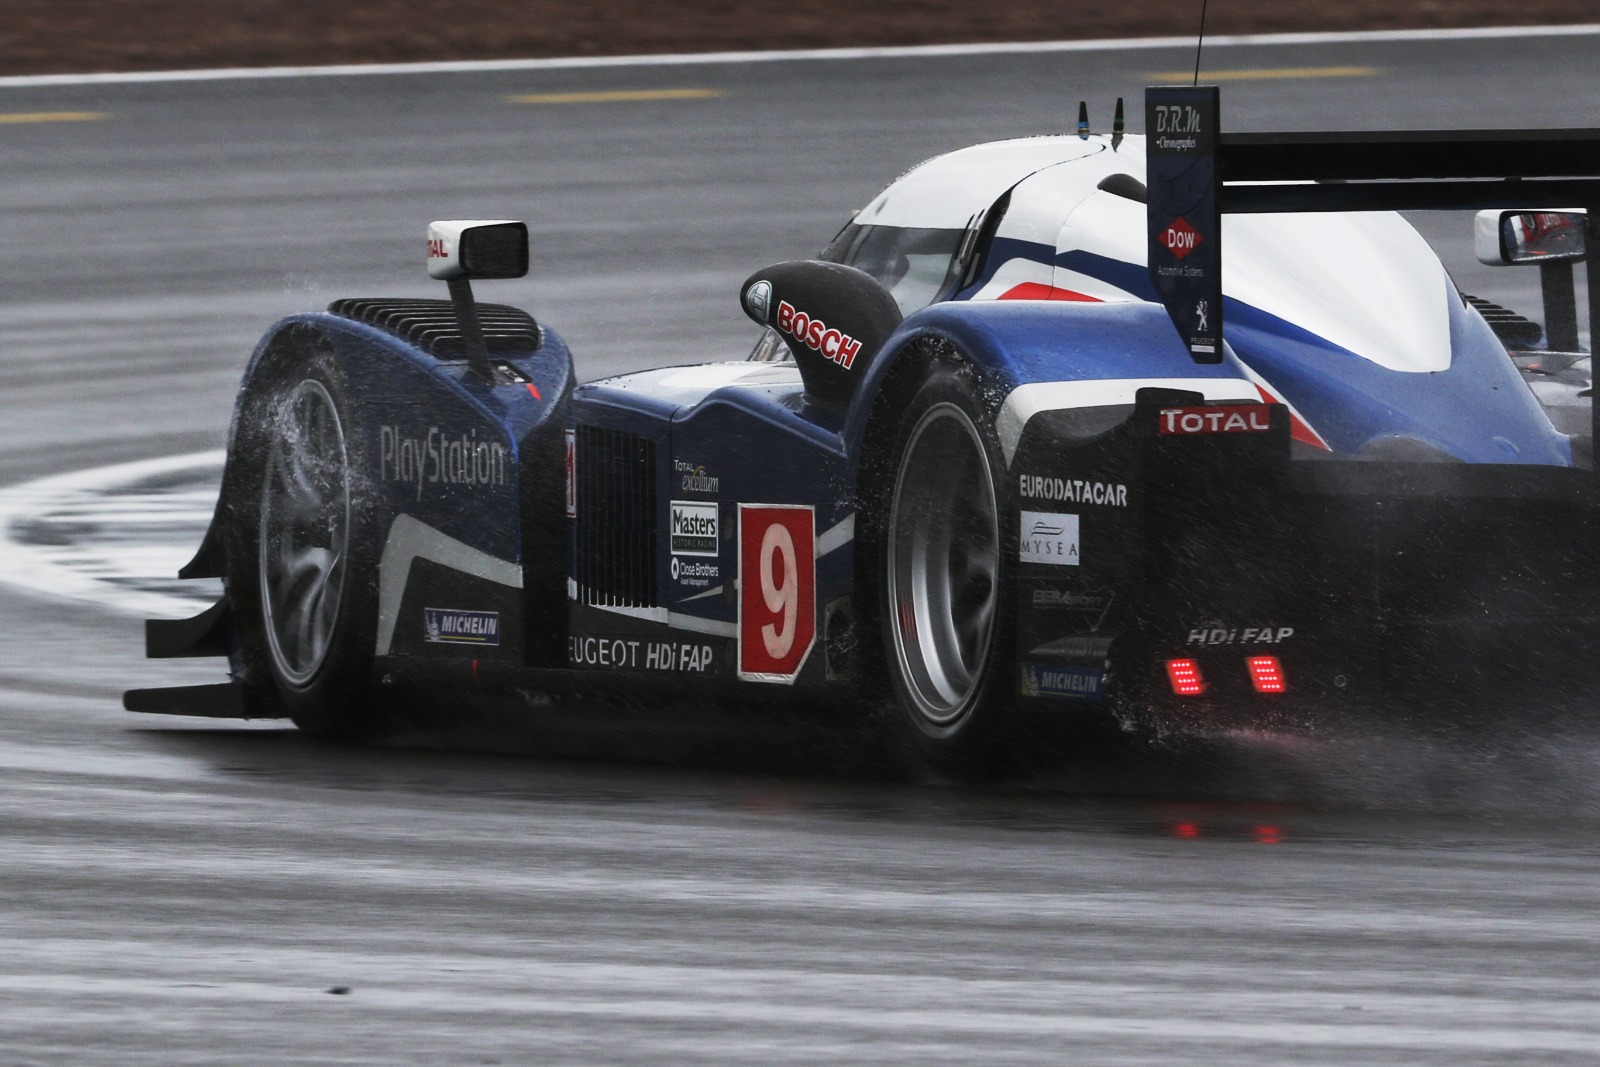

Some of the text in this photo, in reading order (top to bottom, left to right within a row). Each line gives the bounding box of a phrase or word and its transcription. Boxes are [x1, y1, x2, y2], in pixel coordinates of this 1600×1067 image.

[777, 300, 863, 370] BOSCH
[379, 425, 505, 502] PlayStation
[1020, 474, 1127, 507] EURODATACAR
[673, 509, 716, 536] Masters
[673, 537, 696, 549] HISTORIC
[680, 563, 718, 577] Close Brothers
[760, 523, 798, 659] 9
[441, 615, 497, 635] MICHELIN
[1187, 627, 1294, 645] HDi FAP
[646, 642, 676, 670] HDi
[680, 644, 713, 672] FAP
[1041, 671, 1097, 692] MICHELIN
